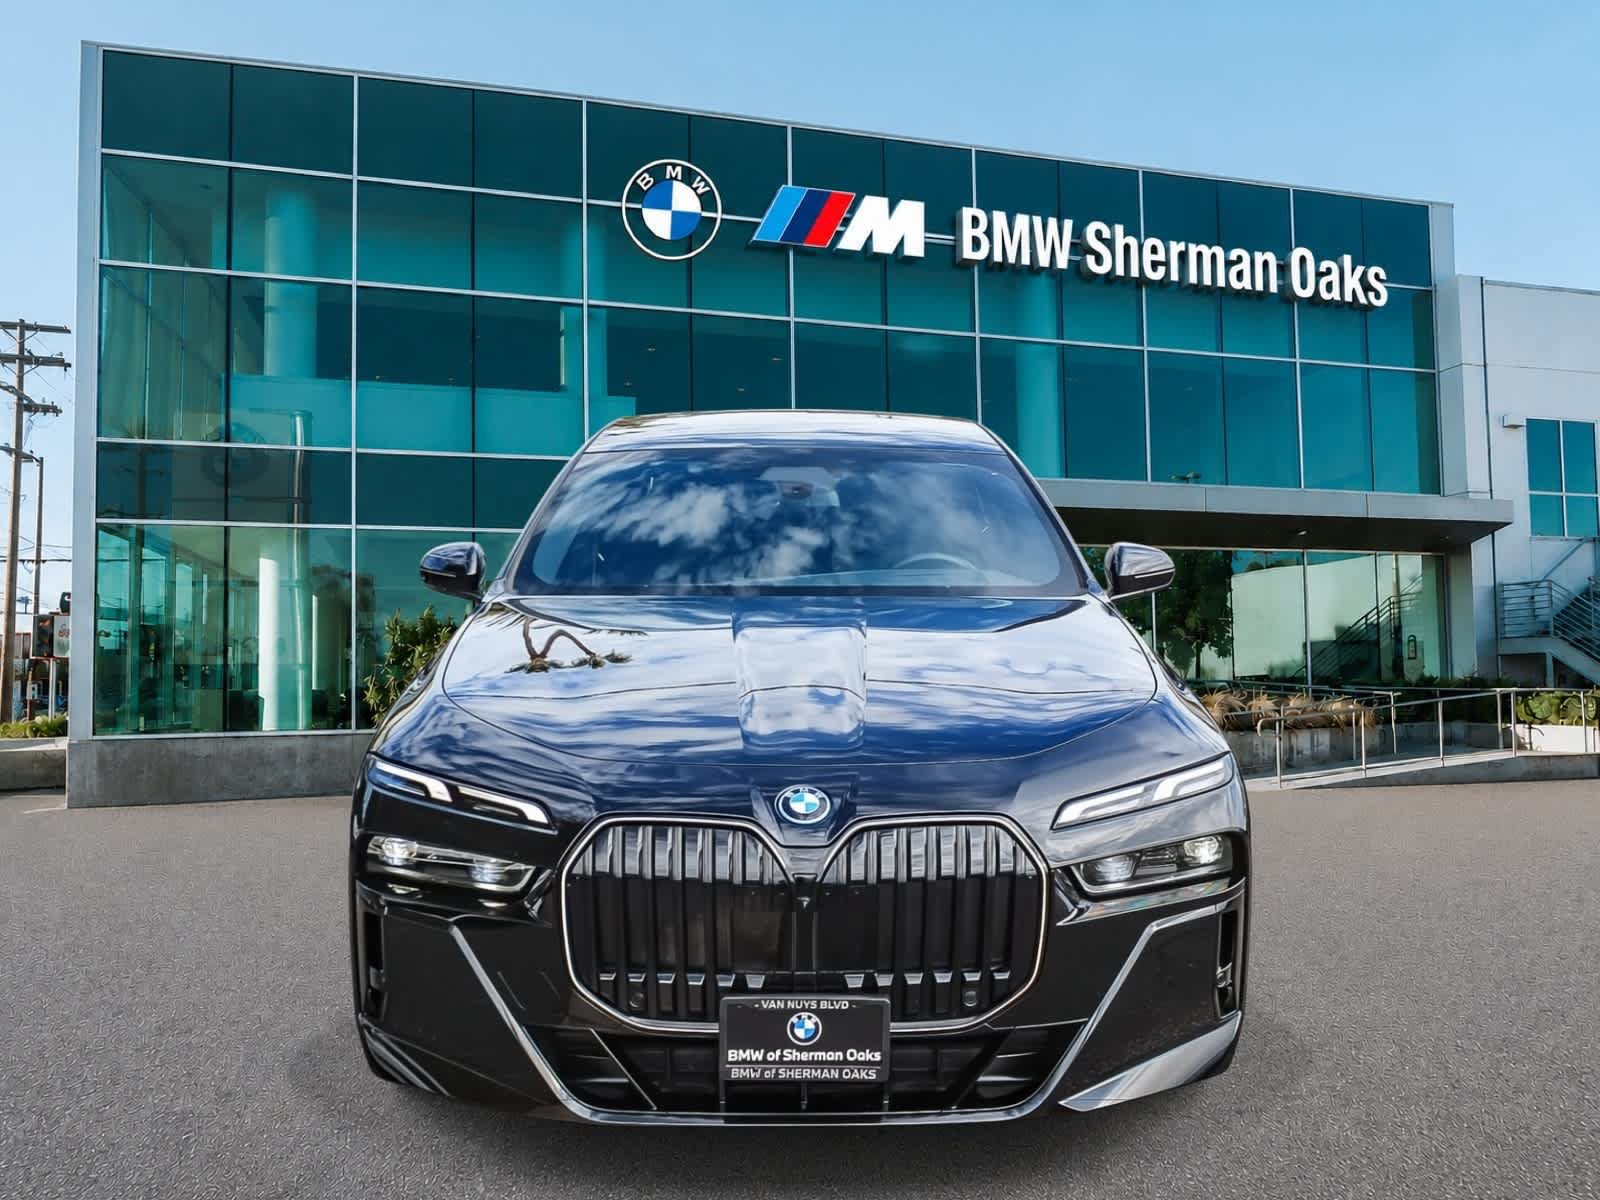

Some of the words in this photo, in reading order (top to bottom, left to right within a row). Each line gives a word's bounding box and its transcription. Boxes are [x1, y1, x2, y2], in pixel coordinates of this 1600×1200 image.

[636, 165, 711, 195] BMW
[960, 206, 1073, 270] BMW
[1085, 220, 1278, 293] Sherman
[1290, 246, 1388, 307] Oaks
[761, 1000, 785, 1010] VAN
[787, 1000, 817, 1010] NUYS
[820, 1000, 849, 1010] BLVD
[728, 1049, 764, 1061] BMW
[766, 1049, 781, 1061] of
[783, 1049, 843, 1061] Sherman
[846, 1049, 882, 1062] Oaks
[731, 1068, 761, 1079] BMW
[764, 1068, 776, 1079] of
[779, 1068, 839, 1079] SHERMAN
[842, 1069, 877, 1080] OAKS
